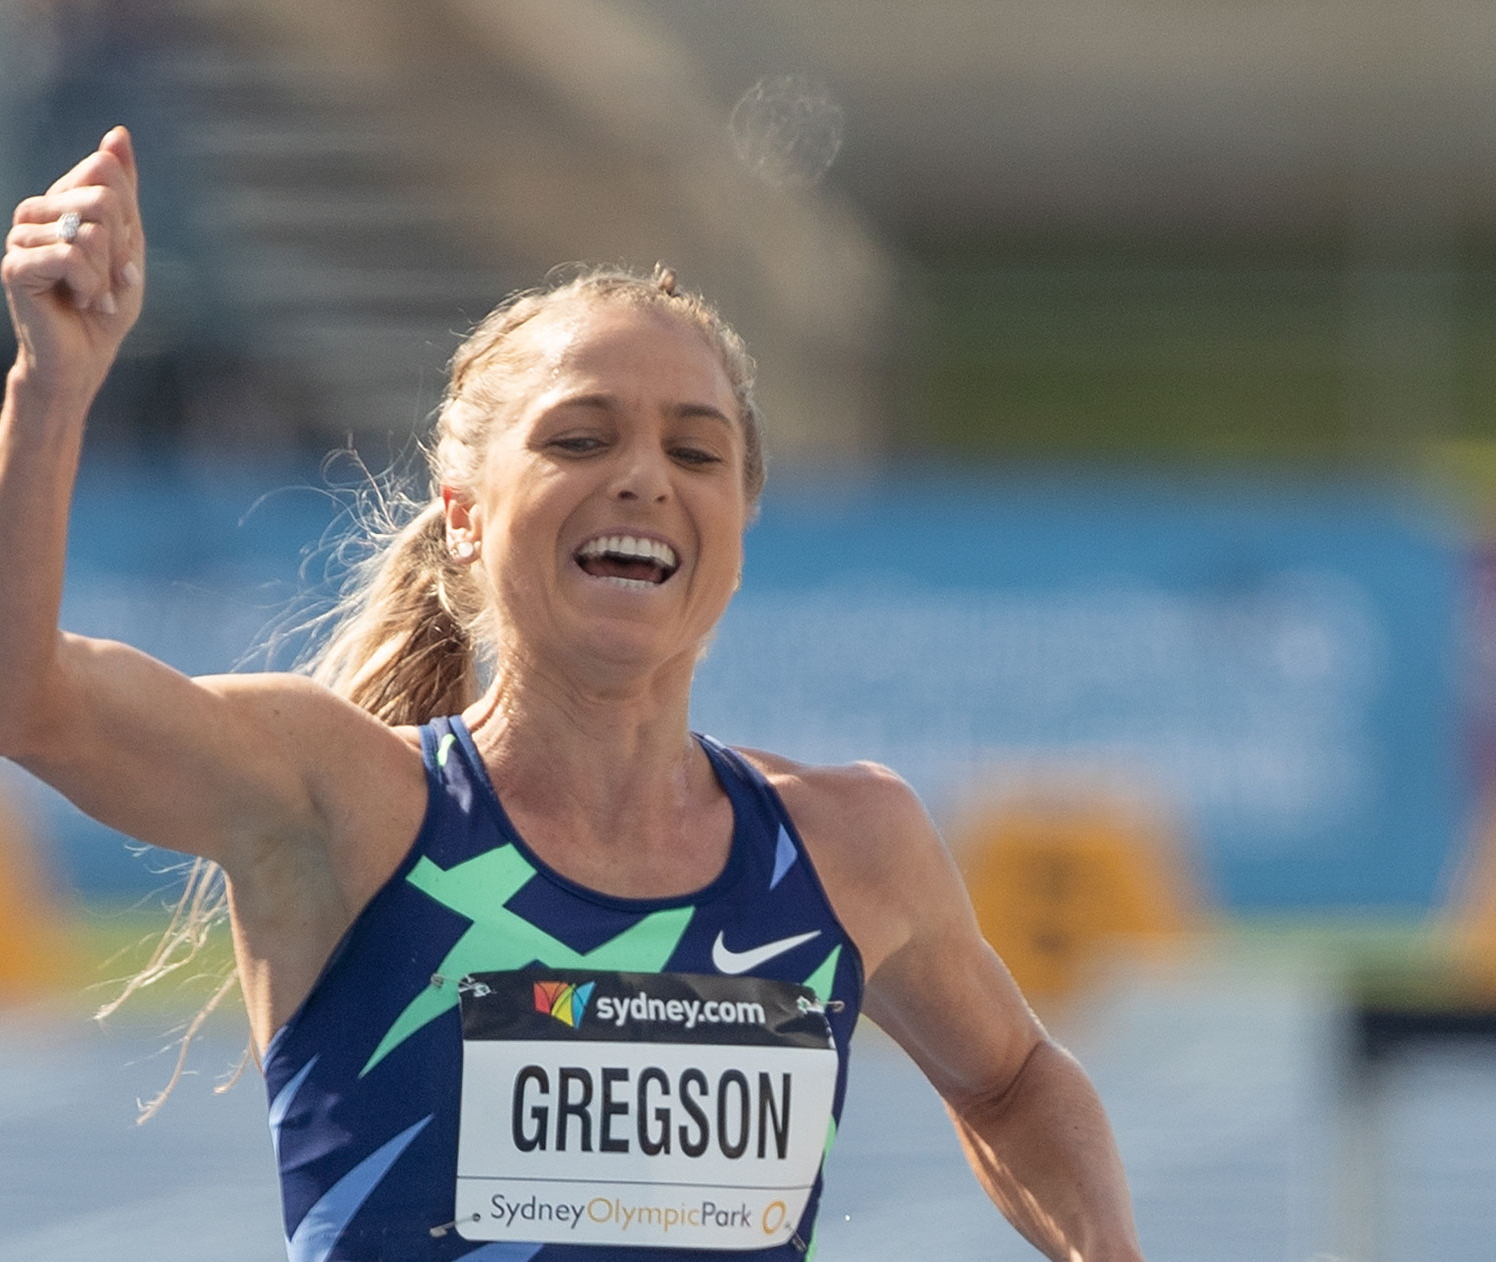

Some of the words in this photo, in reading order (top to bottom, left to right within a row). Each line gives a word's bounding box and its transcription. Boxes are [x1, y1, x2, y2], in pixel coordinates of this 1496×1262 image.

[596, 992, 766, 1028] sydney.com
[512, 1065, 792, 1160] GREGSON
[490, 1194, 752, 1232] SydneyOlympicPark
